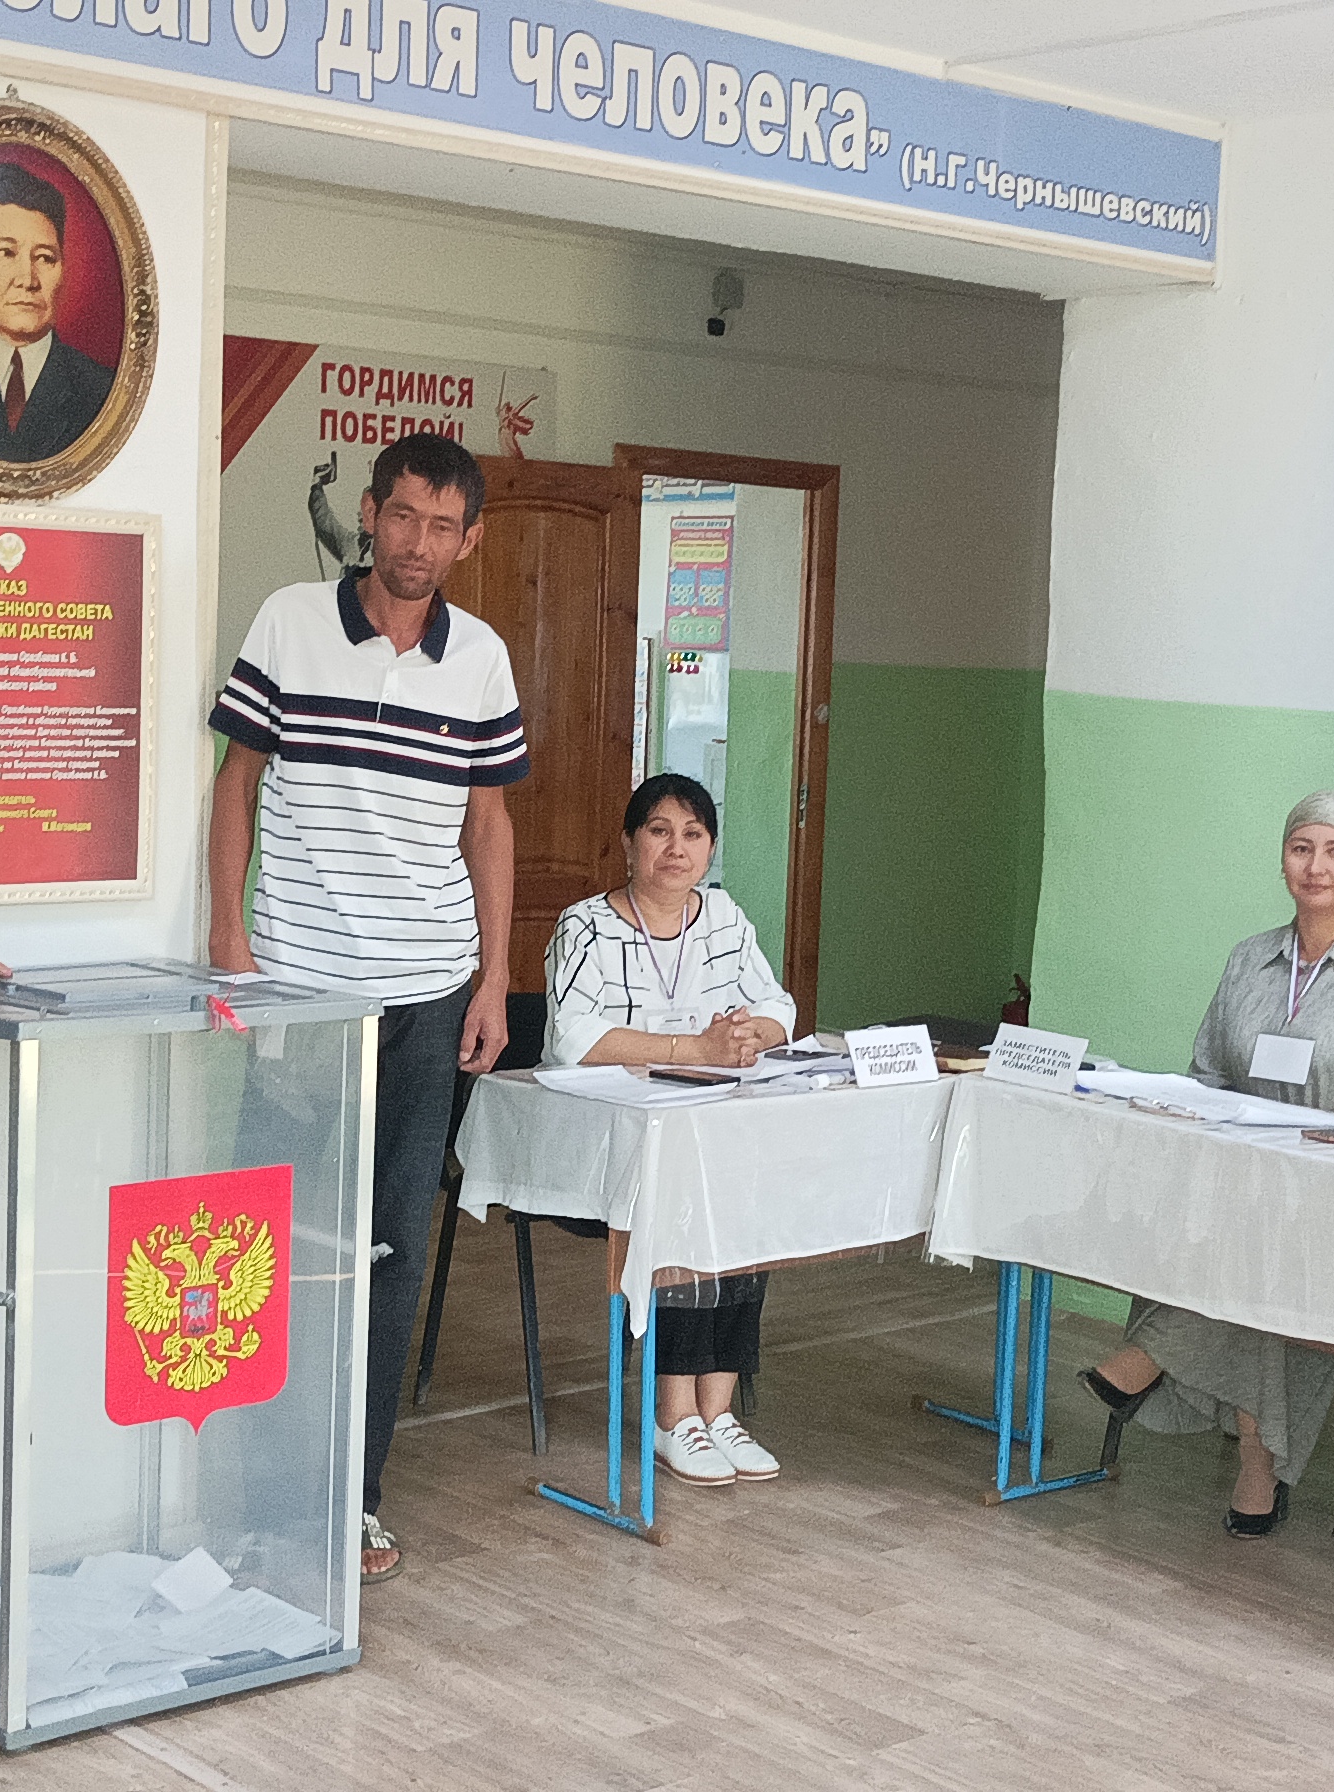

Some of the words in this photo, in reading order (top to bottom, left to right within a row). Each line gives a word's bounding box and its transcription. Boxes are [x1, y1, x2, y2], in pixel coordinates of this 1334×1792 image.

[315, 0, 481, 102] для
[900, 142, 1213, 247] (Н.Г.Чернышевский)
[320, 362, 474, 409] ГОРДИМСЯ
[56, 602, 114, 620] СОВЕТА
[20, 623, 94, 641] ДАГЕСТАН
[854, 1042, 923, 1061] ПРЕДСЕДАТЕЛЬ
[995, 1048, 1071, 1070] ПРЕДСЕДАТЕЛЯ
[1002, 1039, 1071, 1060] ЗАМЕСТИТЕЛЬ
[868, 1059, 918, 1077] КОМИССИИ
[1001, 1059, 1058, 1077] КОМИССИИ
